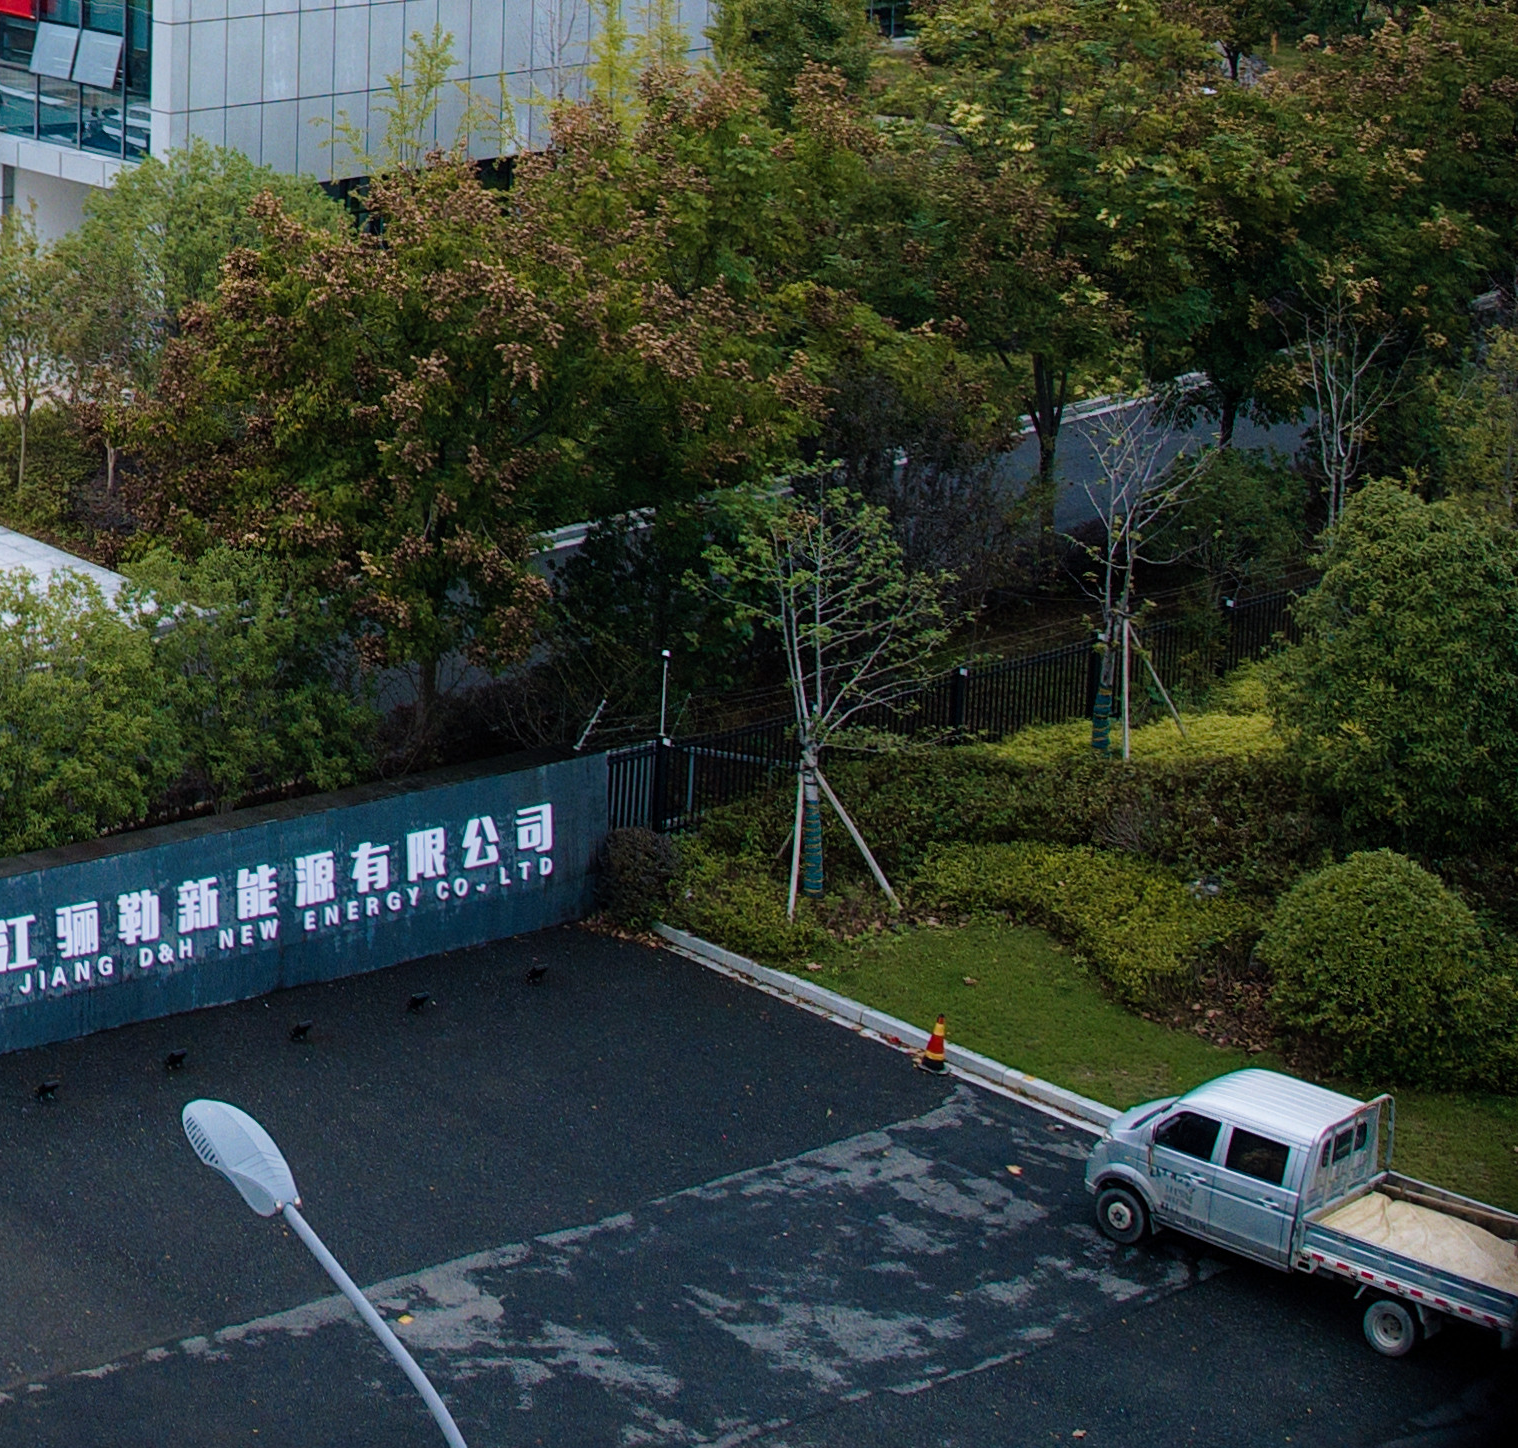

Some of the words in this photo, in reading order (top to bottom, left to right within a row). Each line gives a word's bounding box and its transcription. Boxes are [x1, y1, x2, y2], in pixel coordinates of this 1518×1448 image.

[18, 955, 114, 995] JIANG
[138, 937, 193, 968] D&H
[218, 918, 280, 950] NEW
[303, 886, 420, 932] ENERGY
[499, 856, 554, 887] LTD
